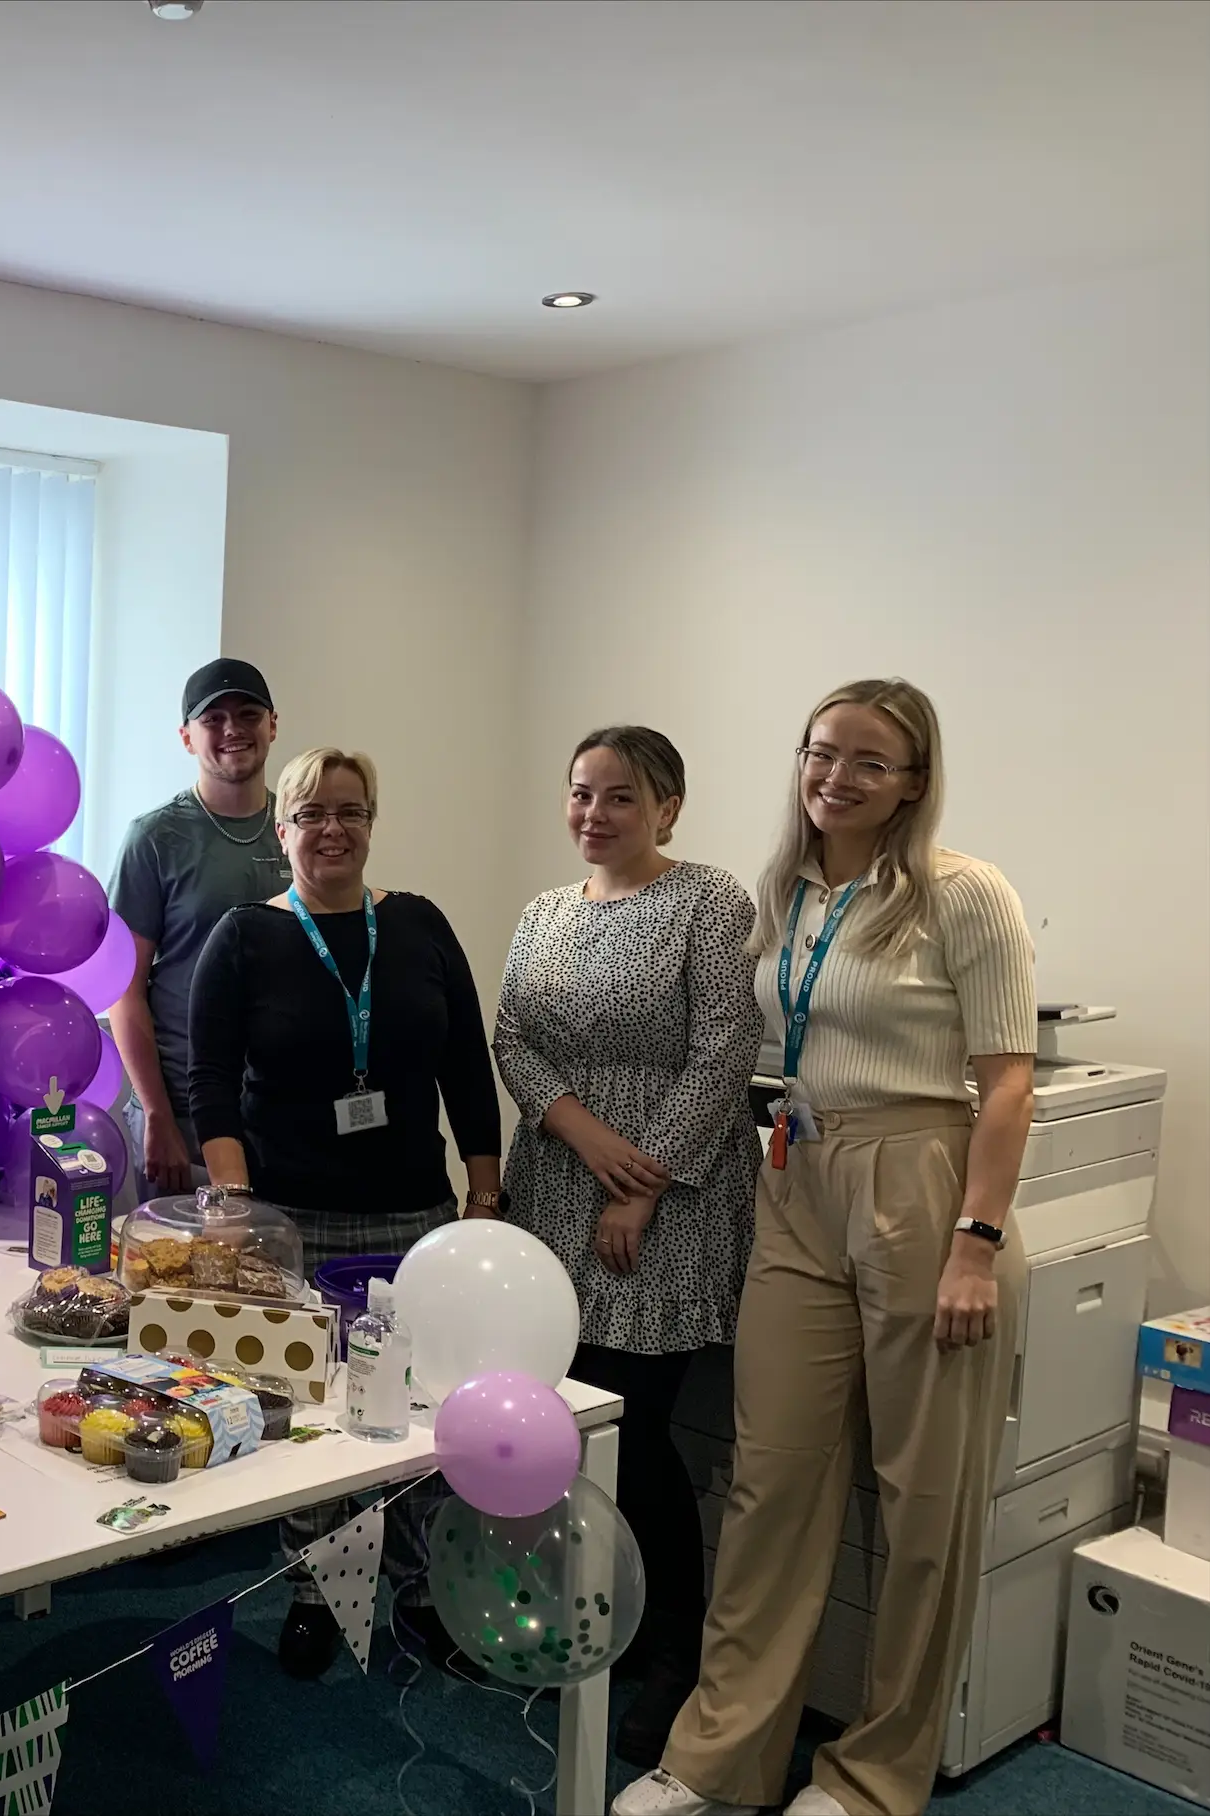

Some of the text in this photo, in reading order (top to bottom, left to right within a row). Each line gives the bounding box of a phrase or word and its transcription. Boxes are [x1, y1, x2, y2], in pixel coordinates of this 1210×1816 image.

[780, 958, 788, 991] PROUD
[803, 960, 819, 993] PROUD
[35, 1114, 70, 1125] MACMILLAN
[74, 1205, 107, 1217] CHANGING
[80, 1195, 104, 1209] LIFE-
[75, 1212, 106, 1224] DONATIONS
[83, 1221, 98, 1232] GO
[79, 1230, 102, 1244] HERE
[169, 1633, 219, 1672] COFFEE
[170, 1639, 194, 1658] WORLD'S
[173, 1653, 213, 1682] MORNING
[1129, 1652, 1161, 1673] Rapid
[1130, 1641, 1204, 1676] Orient Gene's
